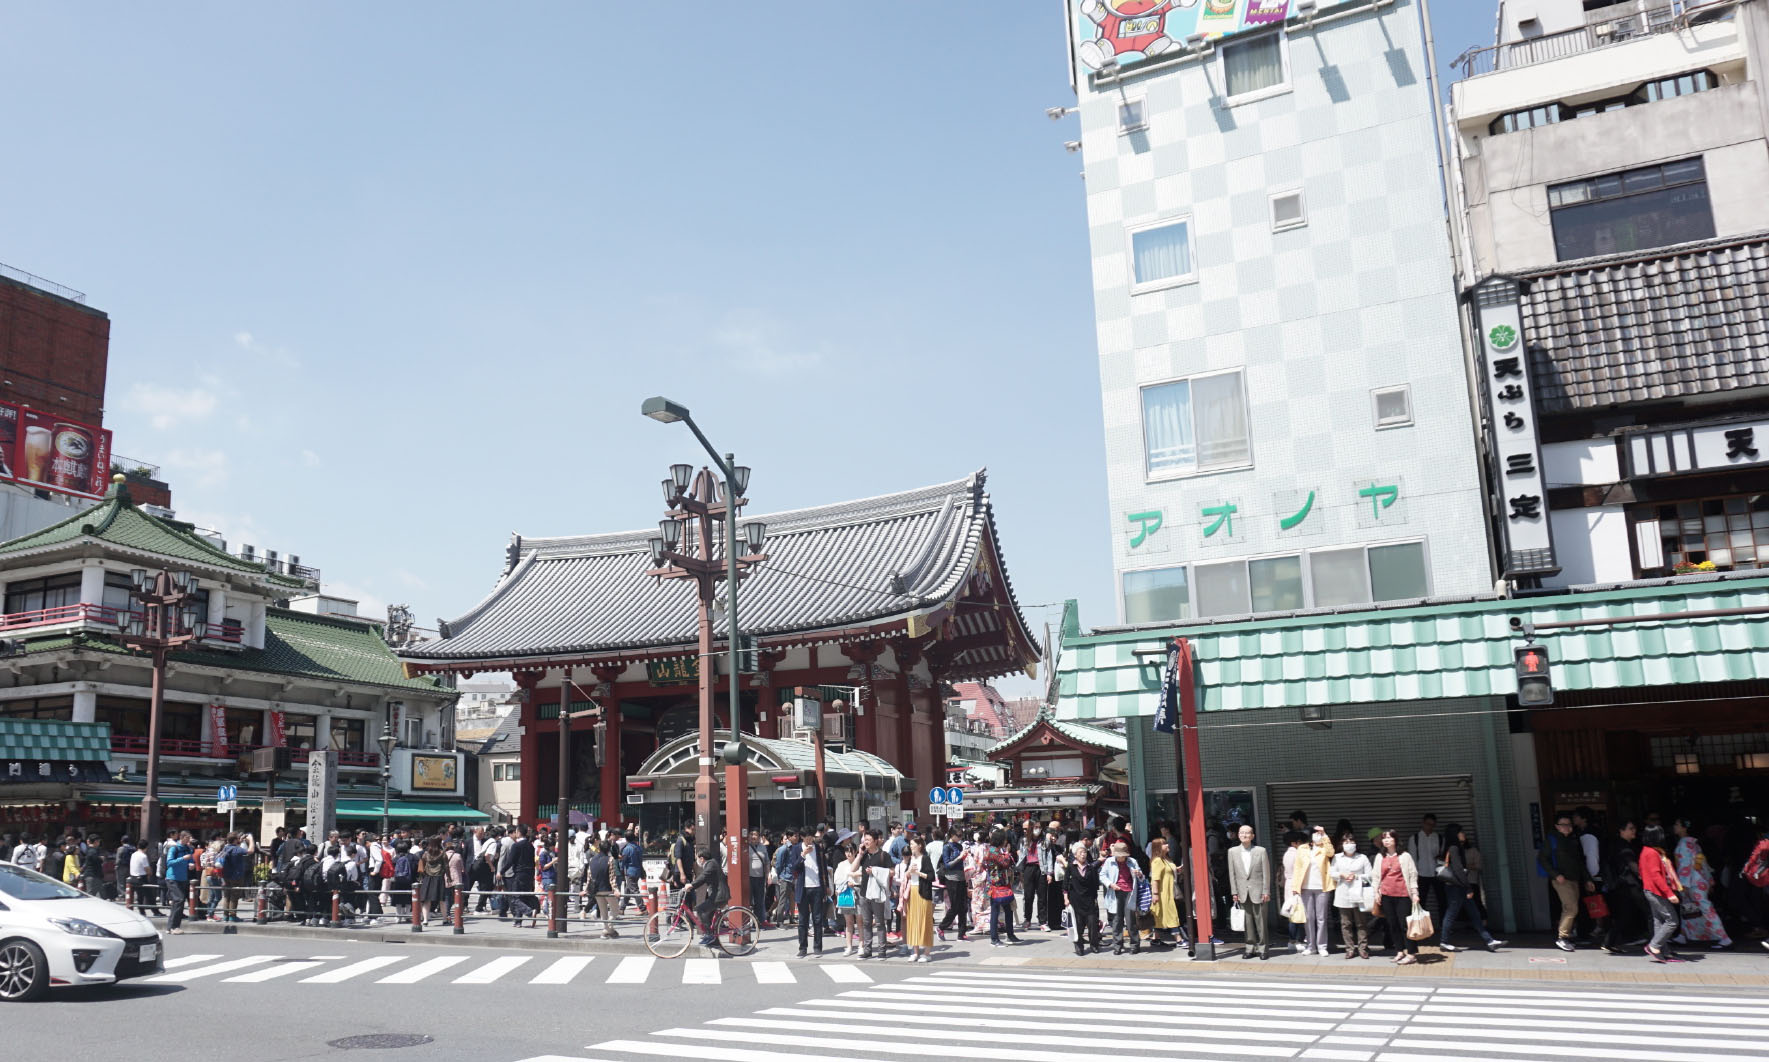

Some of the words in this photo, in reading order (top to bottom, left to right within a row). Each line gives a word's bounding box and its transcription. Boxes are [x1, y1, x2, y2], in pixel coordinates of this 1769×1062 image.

[1250, 7, 1283, 15] MENTAI
[1724, 427, 1759, 459] 天
[1128, 482, 1399, 548] アオノヤ
